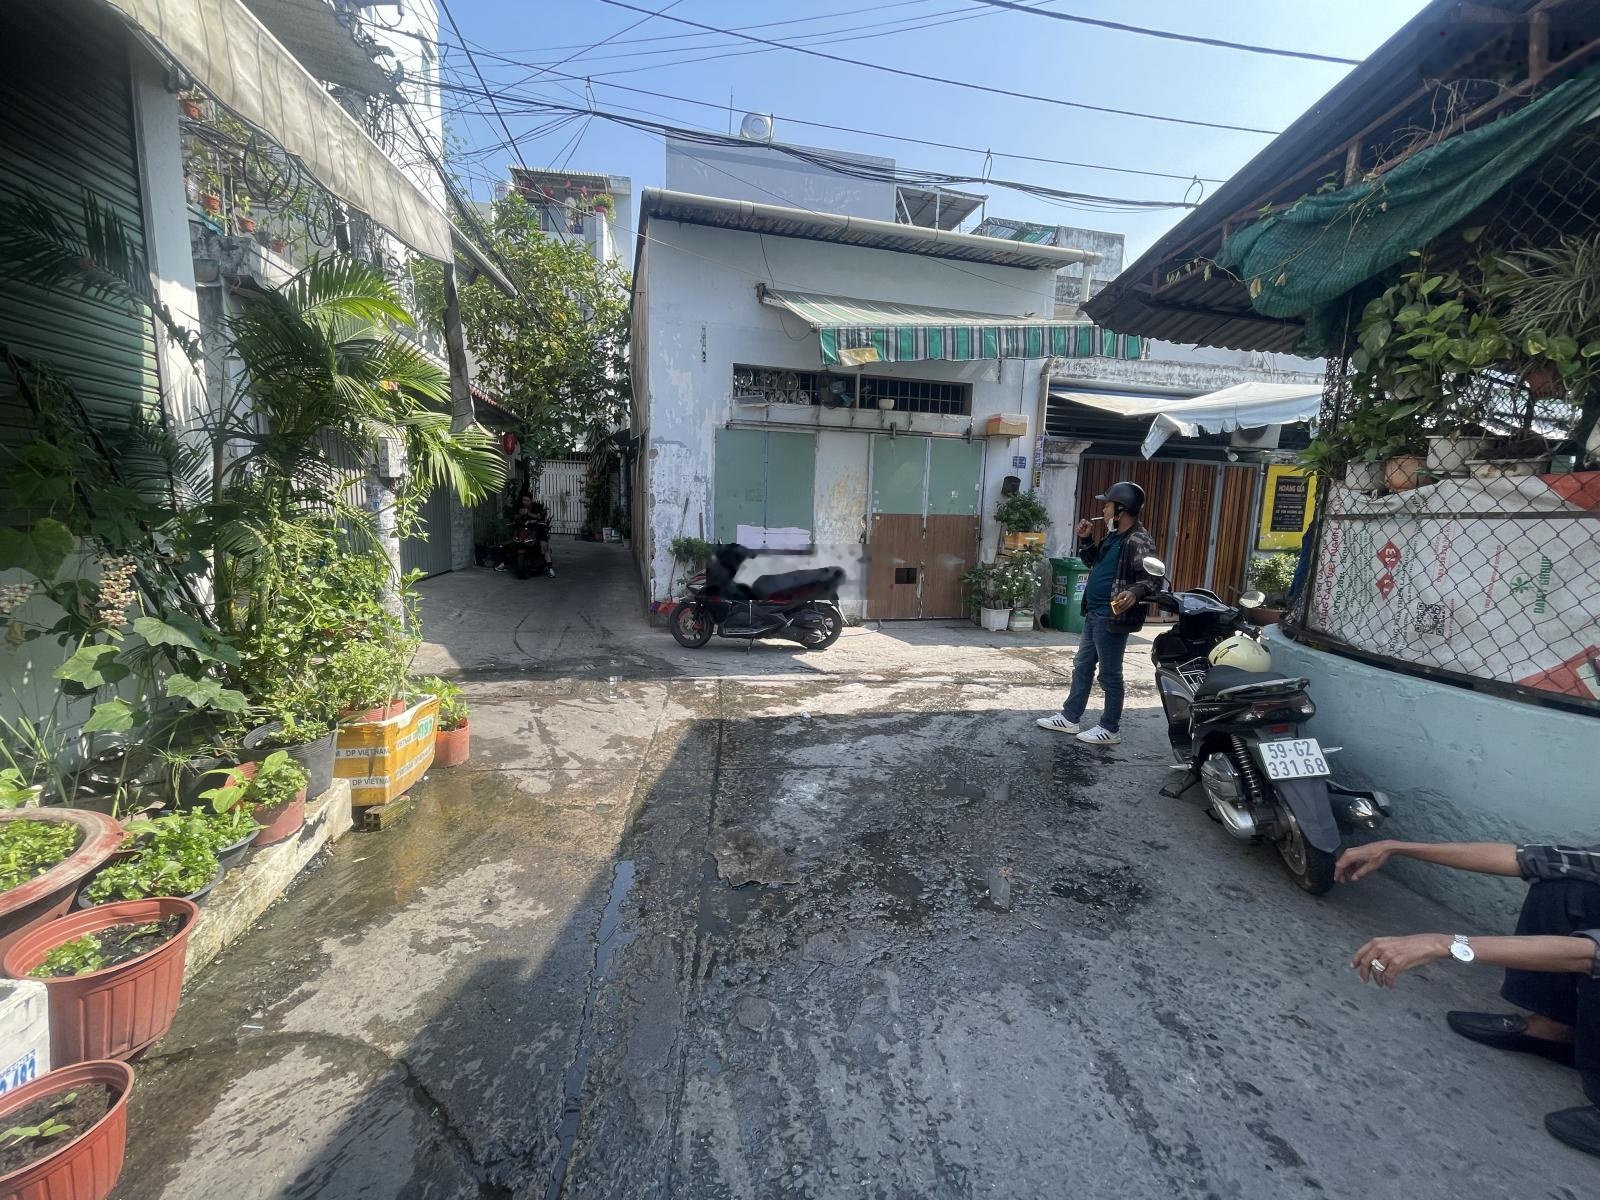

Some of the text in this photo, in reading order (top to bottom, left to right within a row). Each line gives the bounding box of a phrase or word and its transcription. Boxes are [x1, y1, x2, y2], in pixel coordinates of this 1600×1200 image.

[1385, 548, 1396, 564] 13
[1539, 556, 1551, 586] GROUP
[346, 749, 357, 757] DP
[1267, 740, 1314, 759] 59-G2
[1268, 757, 1327, 777] 331.68
